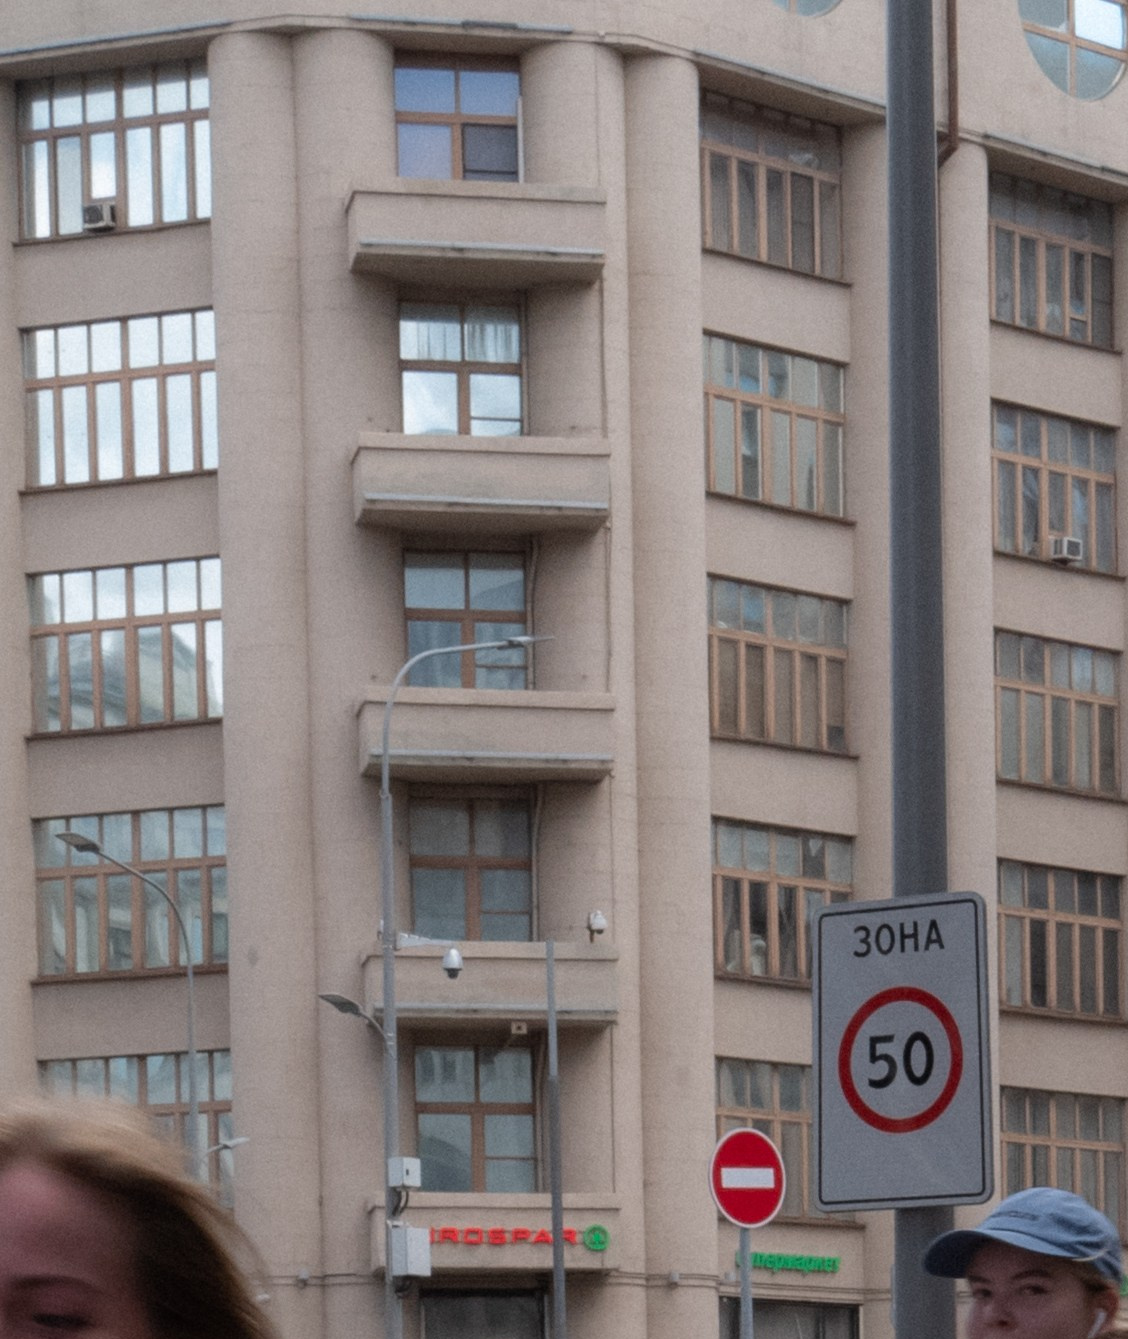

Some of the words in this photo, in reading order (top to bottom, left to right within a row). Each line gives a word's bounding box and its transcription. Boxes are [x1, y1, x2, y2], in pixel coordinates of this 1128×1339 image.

[853, 919, 945, 958] ЗОНА
[868, 1031, 935, 1089] 50
[430, 1227, 577, 1245] ROSPAR
